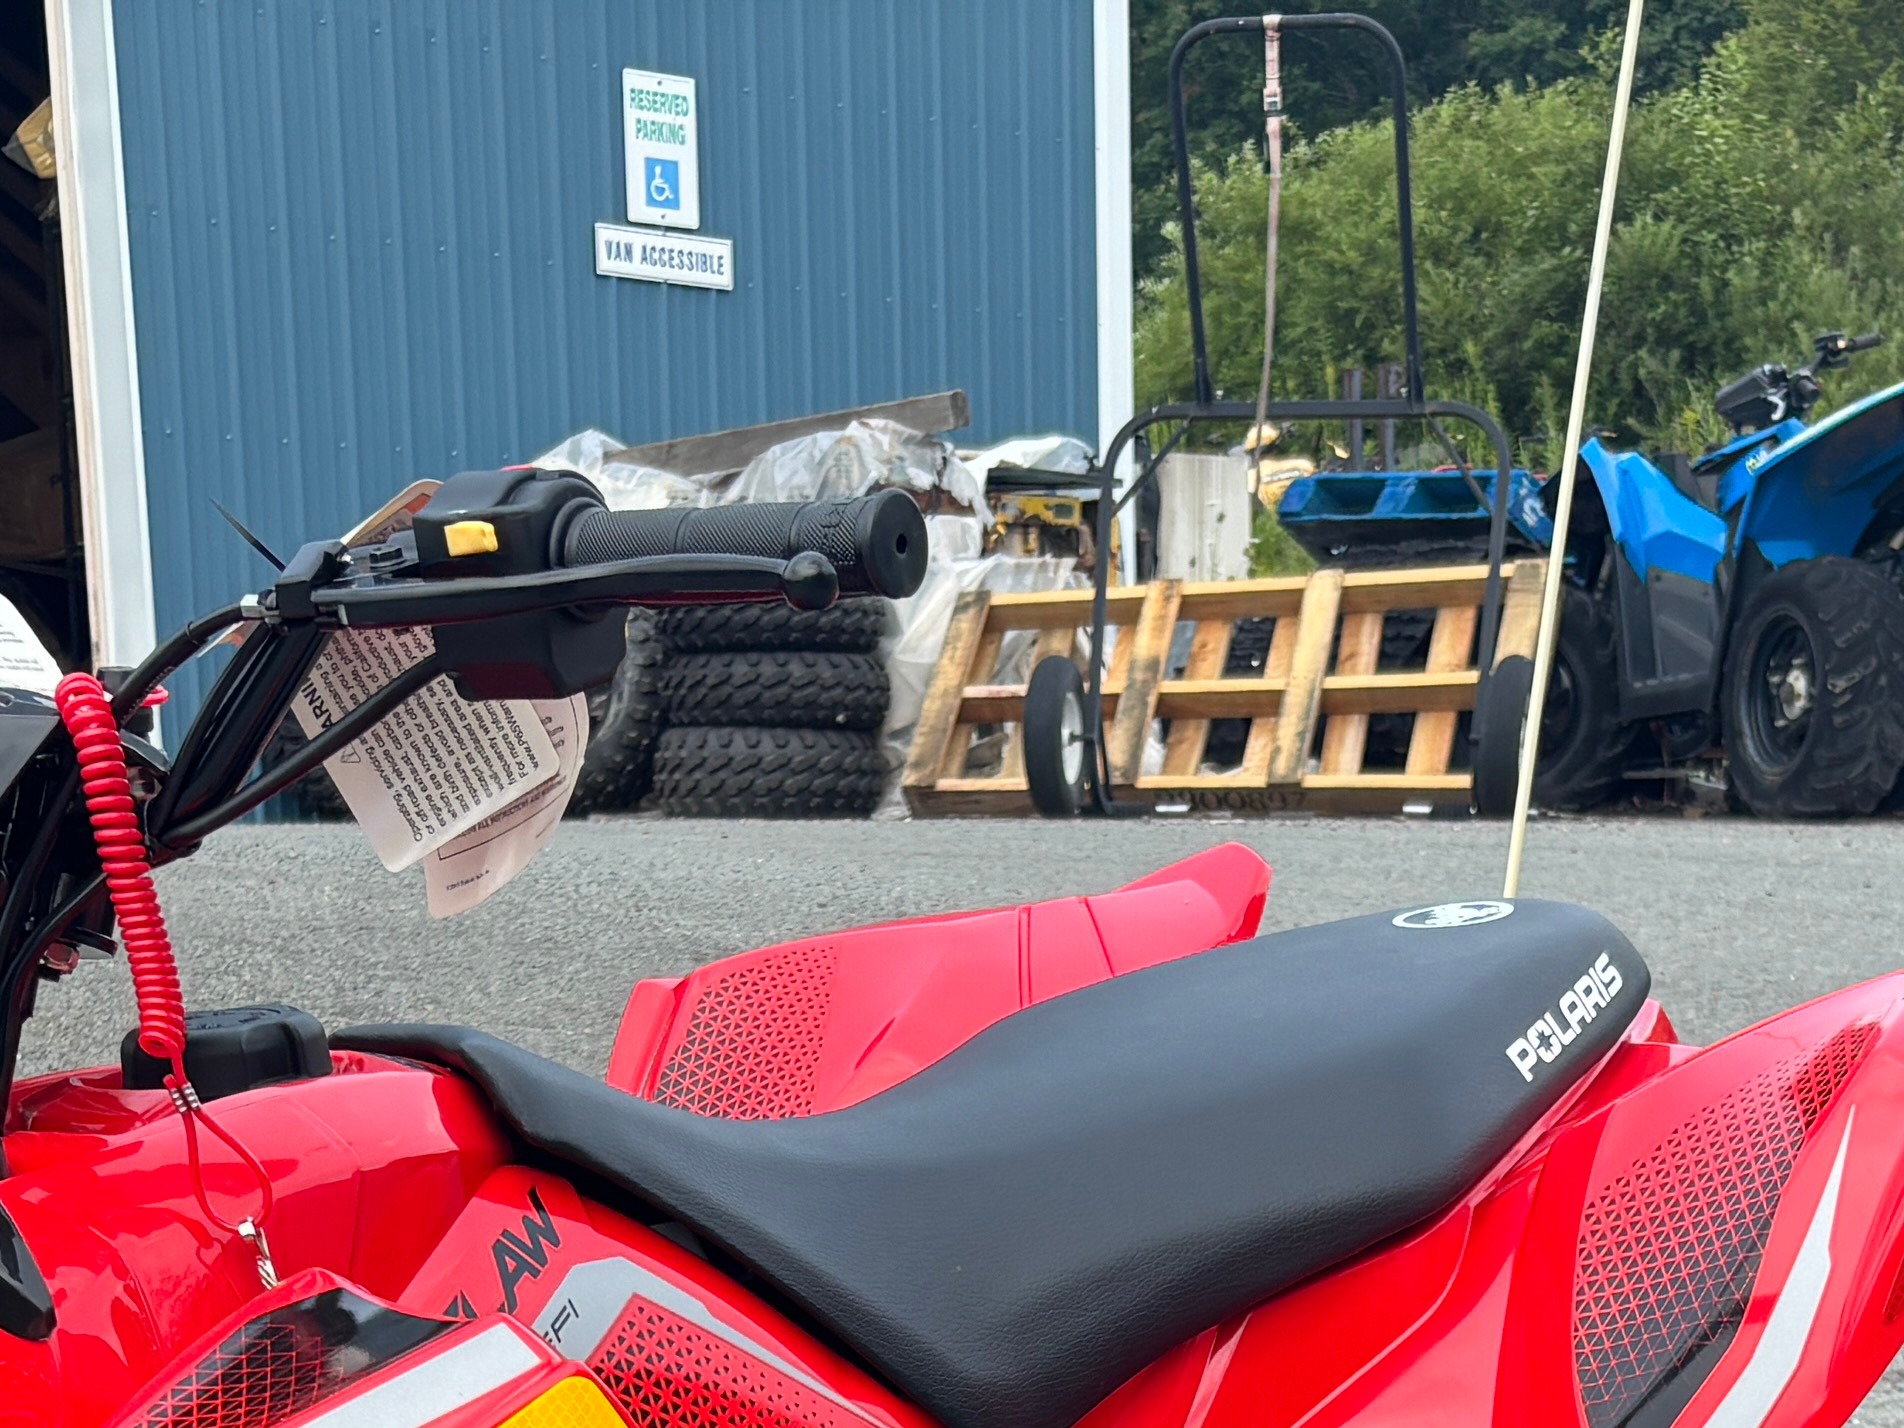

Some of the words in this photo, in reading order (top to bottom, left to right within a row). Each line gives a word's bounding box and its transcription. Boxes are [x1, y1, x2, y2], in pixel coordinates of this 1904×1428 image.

[630, 88, 690, 117] RESERVED
[635, 118, 686, 146] PARKING
[604, 239, 634, 264] VAN
[640, 245, 725, 276] ACCESSIBLE
[436, 677, 453, 700] and
[299, 679, 336, 731] ARNI
[390, 709, 406, 729] the
[399, 697, 418, 722] othe
[370, 727, 386, 749] can
[419, 731, 447, 772] defects
[498, 731, 520, 760] more
[379, 746, 407, 785] vehicle
[407, 738, 433, 775] known
[512, 757, 529, 778] For
[423, 791, 449, 828] engine
[1505, 952, 1623, 1082] POLARIS
